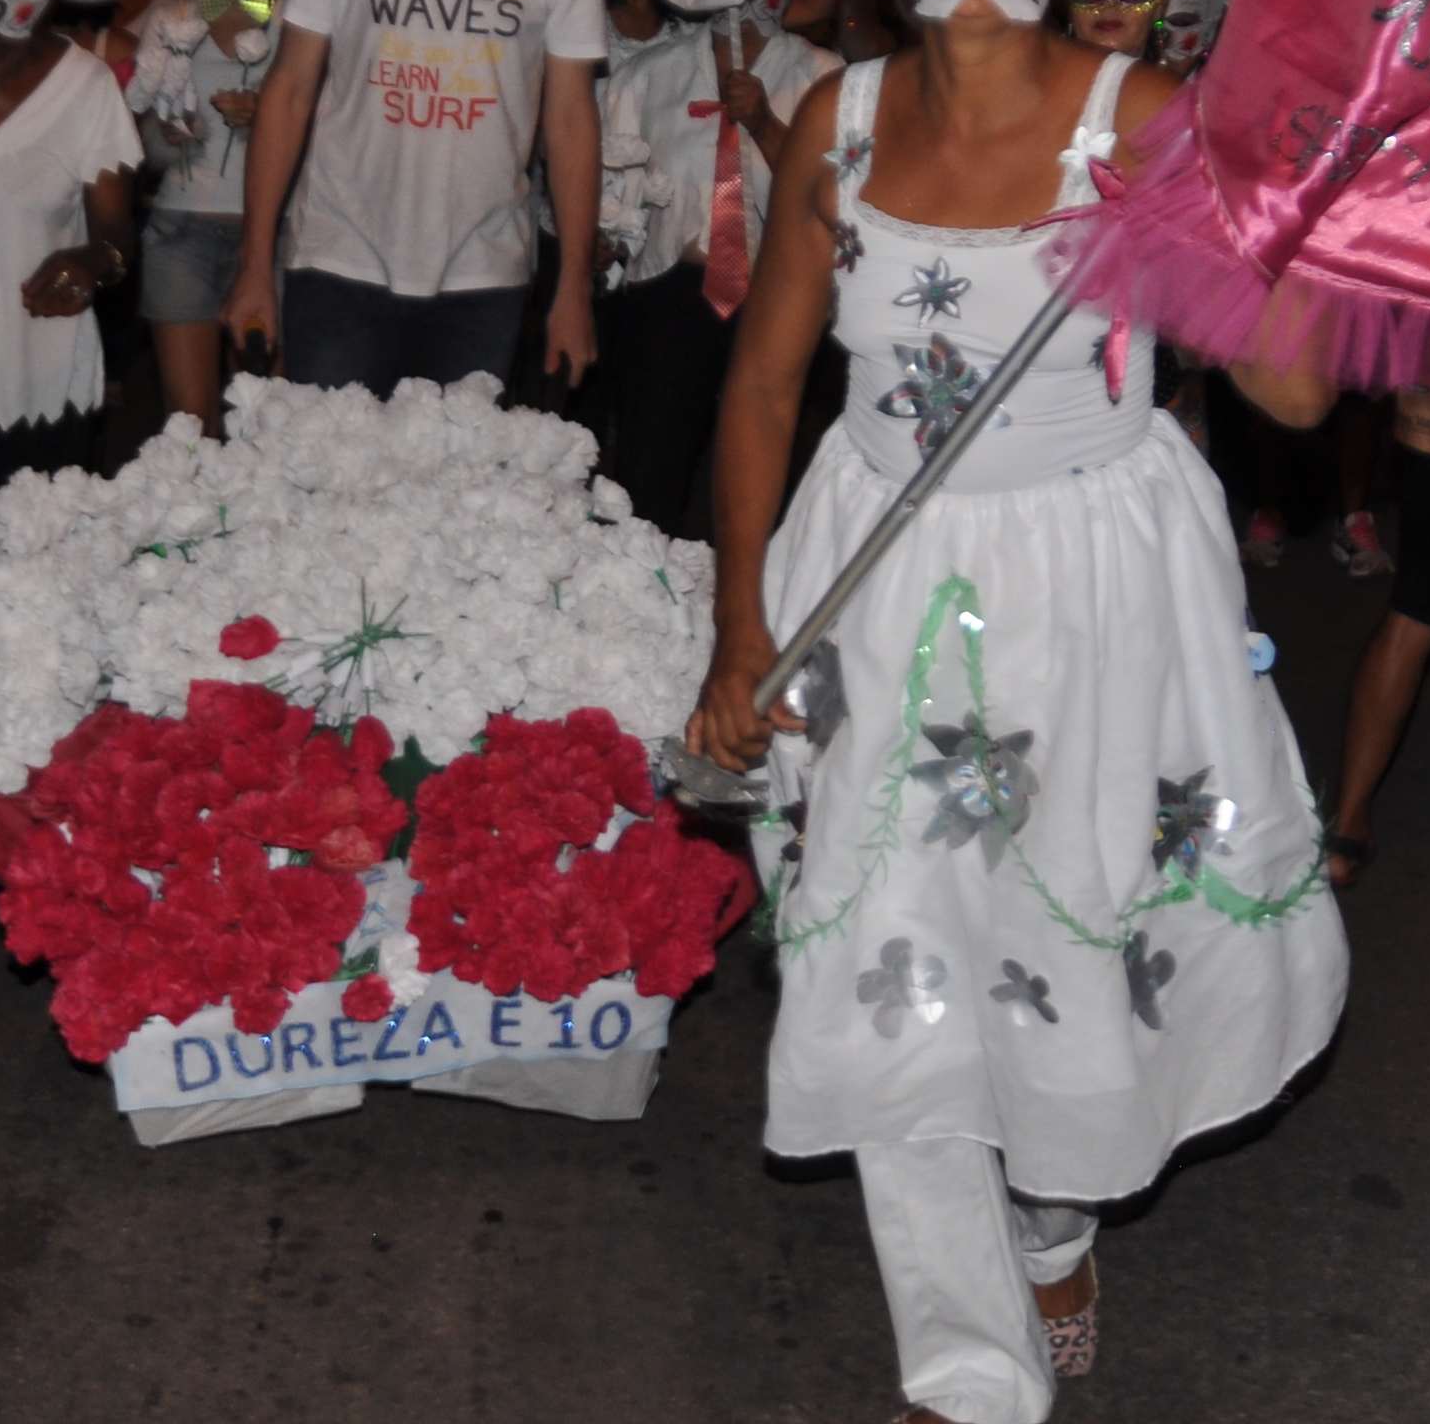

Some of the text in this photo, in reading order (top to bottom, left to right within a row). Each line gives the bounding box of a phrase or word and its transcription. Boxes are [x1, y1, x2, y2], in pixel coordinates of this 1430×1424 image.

[367, 60, 440, 93] LEARN
[384, 89, 498, 131] SURF
[172, 1000, 464, 1092] DUREZA
[548, 1000, 633, 1052] 10
